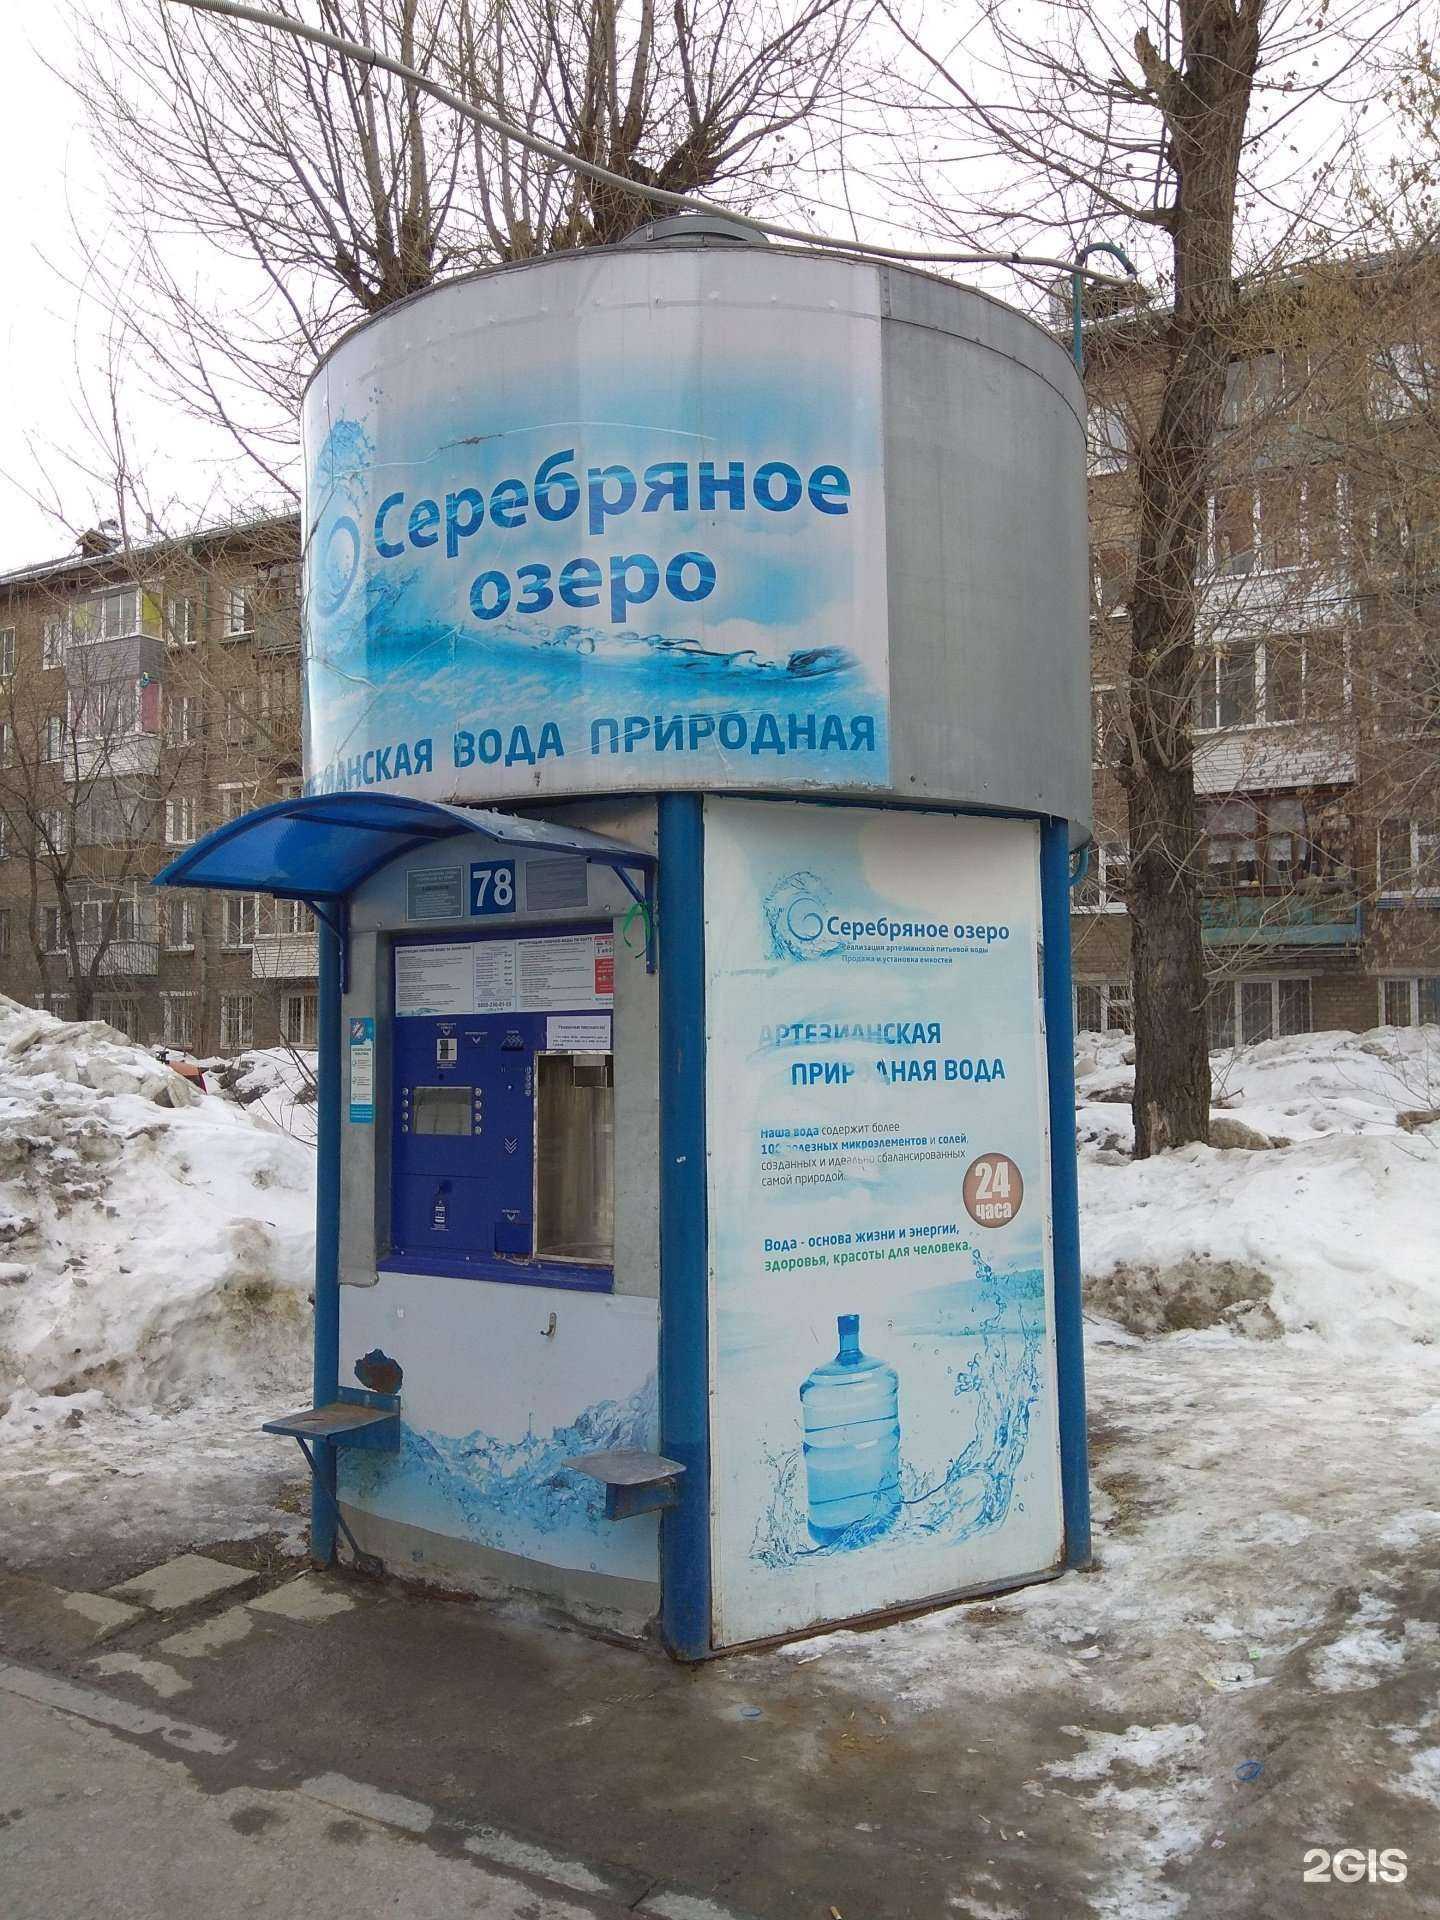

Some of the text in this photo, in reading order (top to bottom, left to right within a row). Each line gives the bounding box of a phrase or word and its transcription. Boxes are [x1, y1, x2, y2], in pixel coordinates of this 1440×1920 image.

[374, 448, 851, 560] Серебряное
[469, 551, 717, 624] озеро
[454, 721, 564, 768] ВОДА
[591, 712, 876, 756] ПРИРОДНАЯ
[472, 868, 512, 906] 78
[827, 915, 1010, 944] Серебряное озеро
[944, 1057, 1006, 1084] ВОДА
[760, 1121, 900, 1139] Наша вода содержит более
[841, 1136, 928, 1149] микроэлементов
[761, 1159, 817, 1171] созданных
[877, 1149, 966, 1164] сбалансированных
[761, 1173, 793, 1187] самой
[975, 1162, 1012, 1200] 24
[975, 1201, 1012, 1221] часа
[764, 1238, 798, 1252] Вода
[808, 1232, 851, 1248] основа
[855, 1229, 896, 1243] жизни
[899, 1228, 906, 1239] и
[909, 1223, 960, 1240] энергии,
[764, 1240, 973, 1273] здоровья, красоты для человека.
